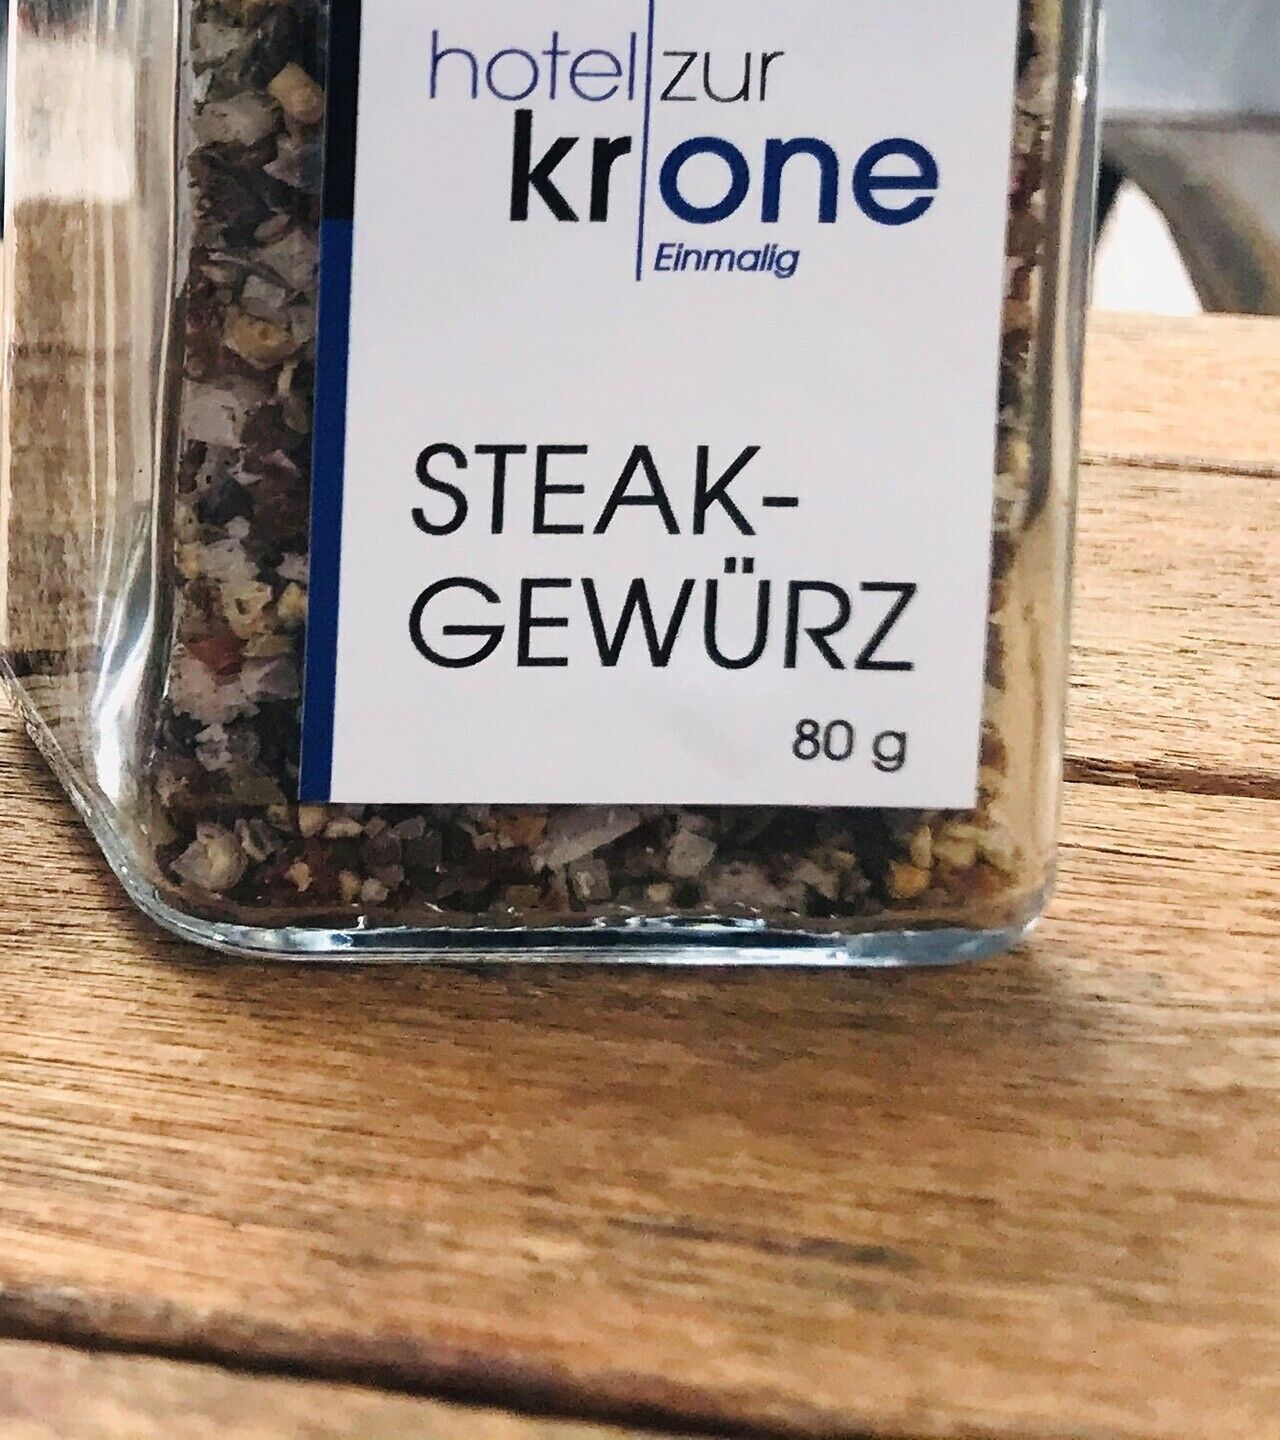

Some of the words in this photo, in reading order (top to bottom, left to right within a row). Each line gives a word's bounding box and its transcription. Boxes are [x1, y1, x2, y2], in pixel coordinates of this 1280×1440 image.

[430, 30, 637, 102] hotel
[660, 51, 785, 103] zur
[654, 243, 800, 279] Einmalig
[411, 443, 799, 536] STEAK-
[408, 557, 919, 672] GEWÜRZ
[792, 719, 855, 761] 80
[872, 730, 907, 773] g
